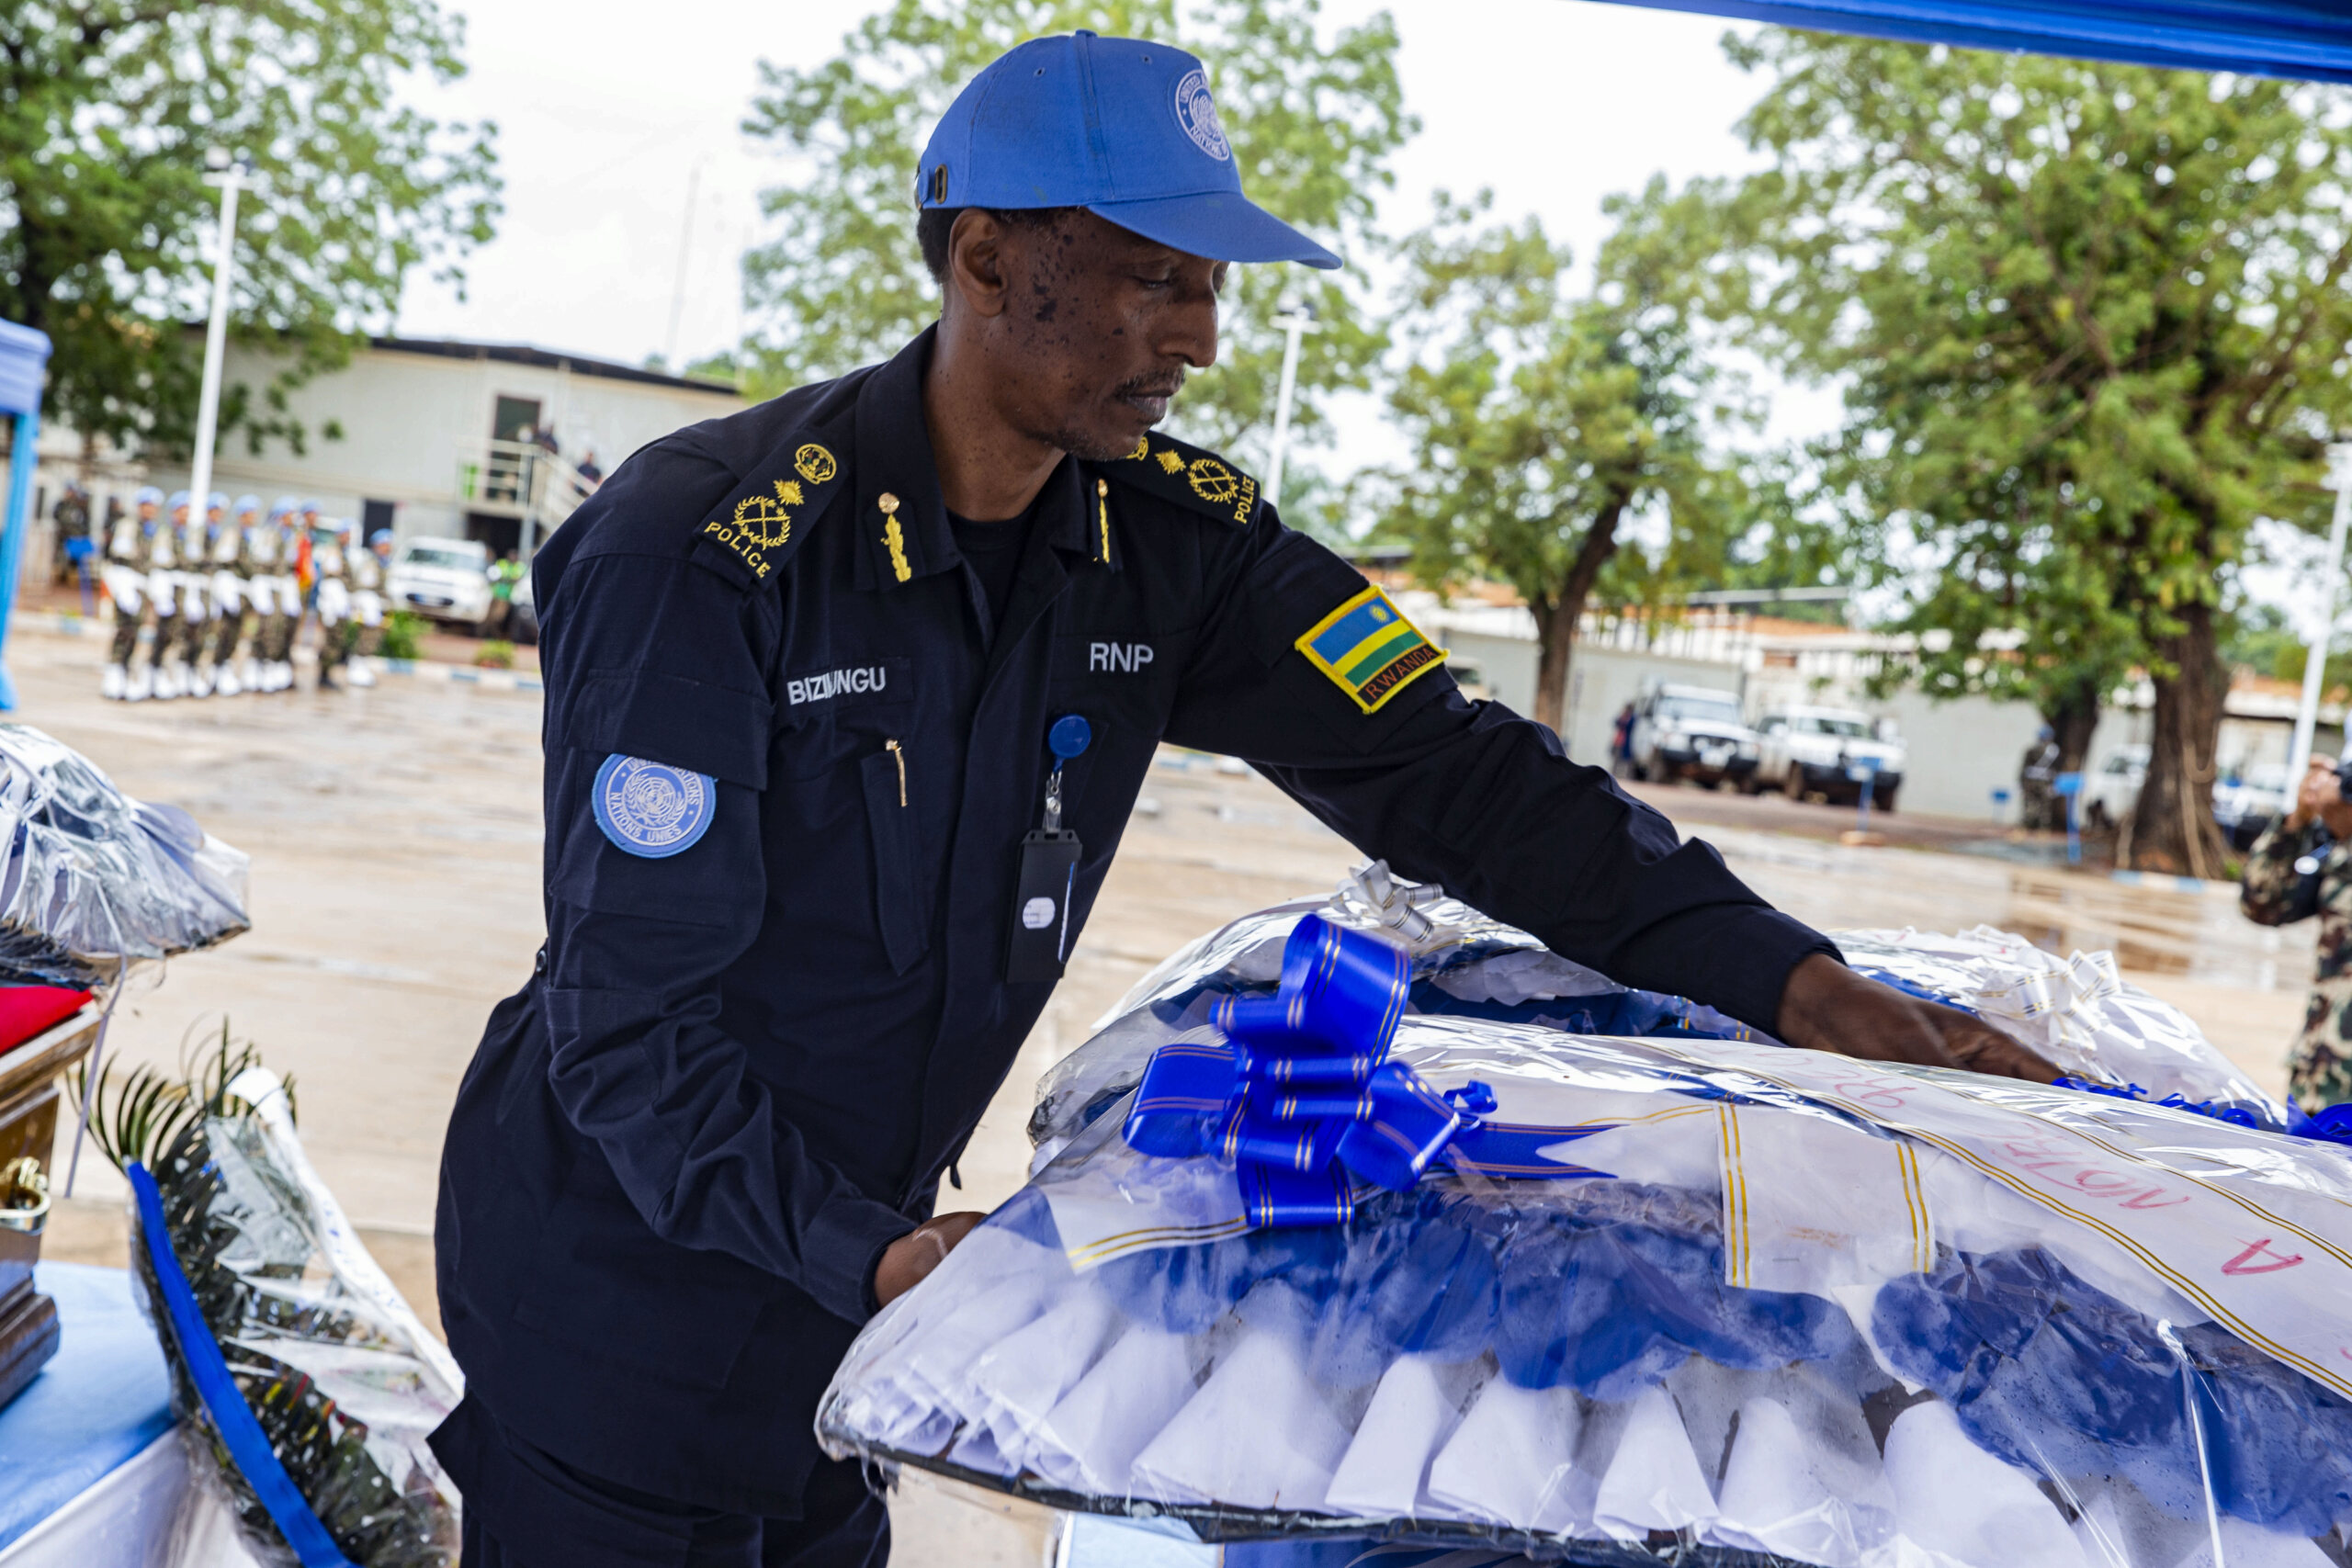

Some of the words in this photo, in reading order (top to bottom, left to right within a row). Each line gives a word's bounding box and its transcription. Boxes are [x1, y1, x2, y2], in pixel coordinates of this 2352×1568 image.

[1234, 475, 1255, 525] POLICE
[704, 522, 771, 579] POLICE
[1089, 642, 1154, 672] RNP
[1365, 648, 1437, 700] RWANDA
[786, 666, 887, 705] BIZIUNGU
[672, 766, 699, 806] ATIONS
[610, 792, 643, 838] NATIONS
[2220, 1236, 2305, 1276] A
